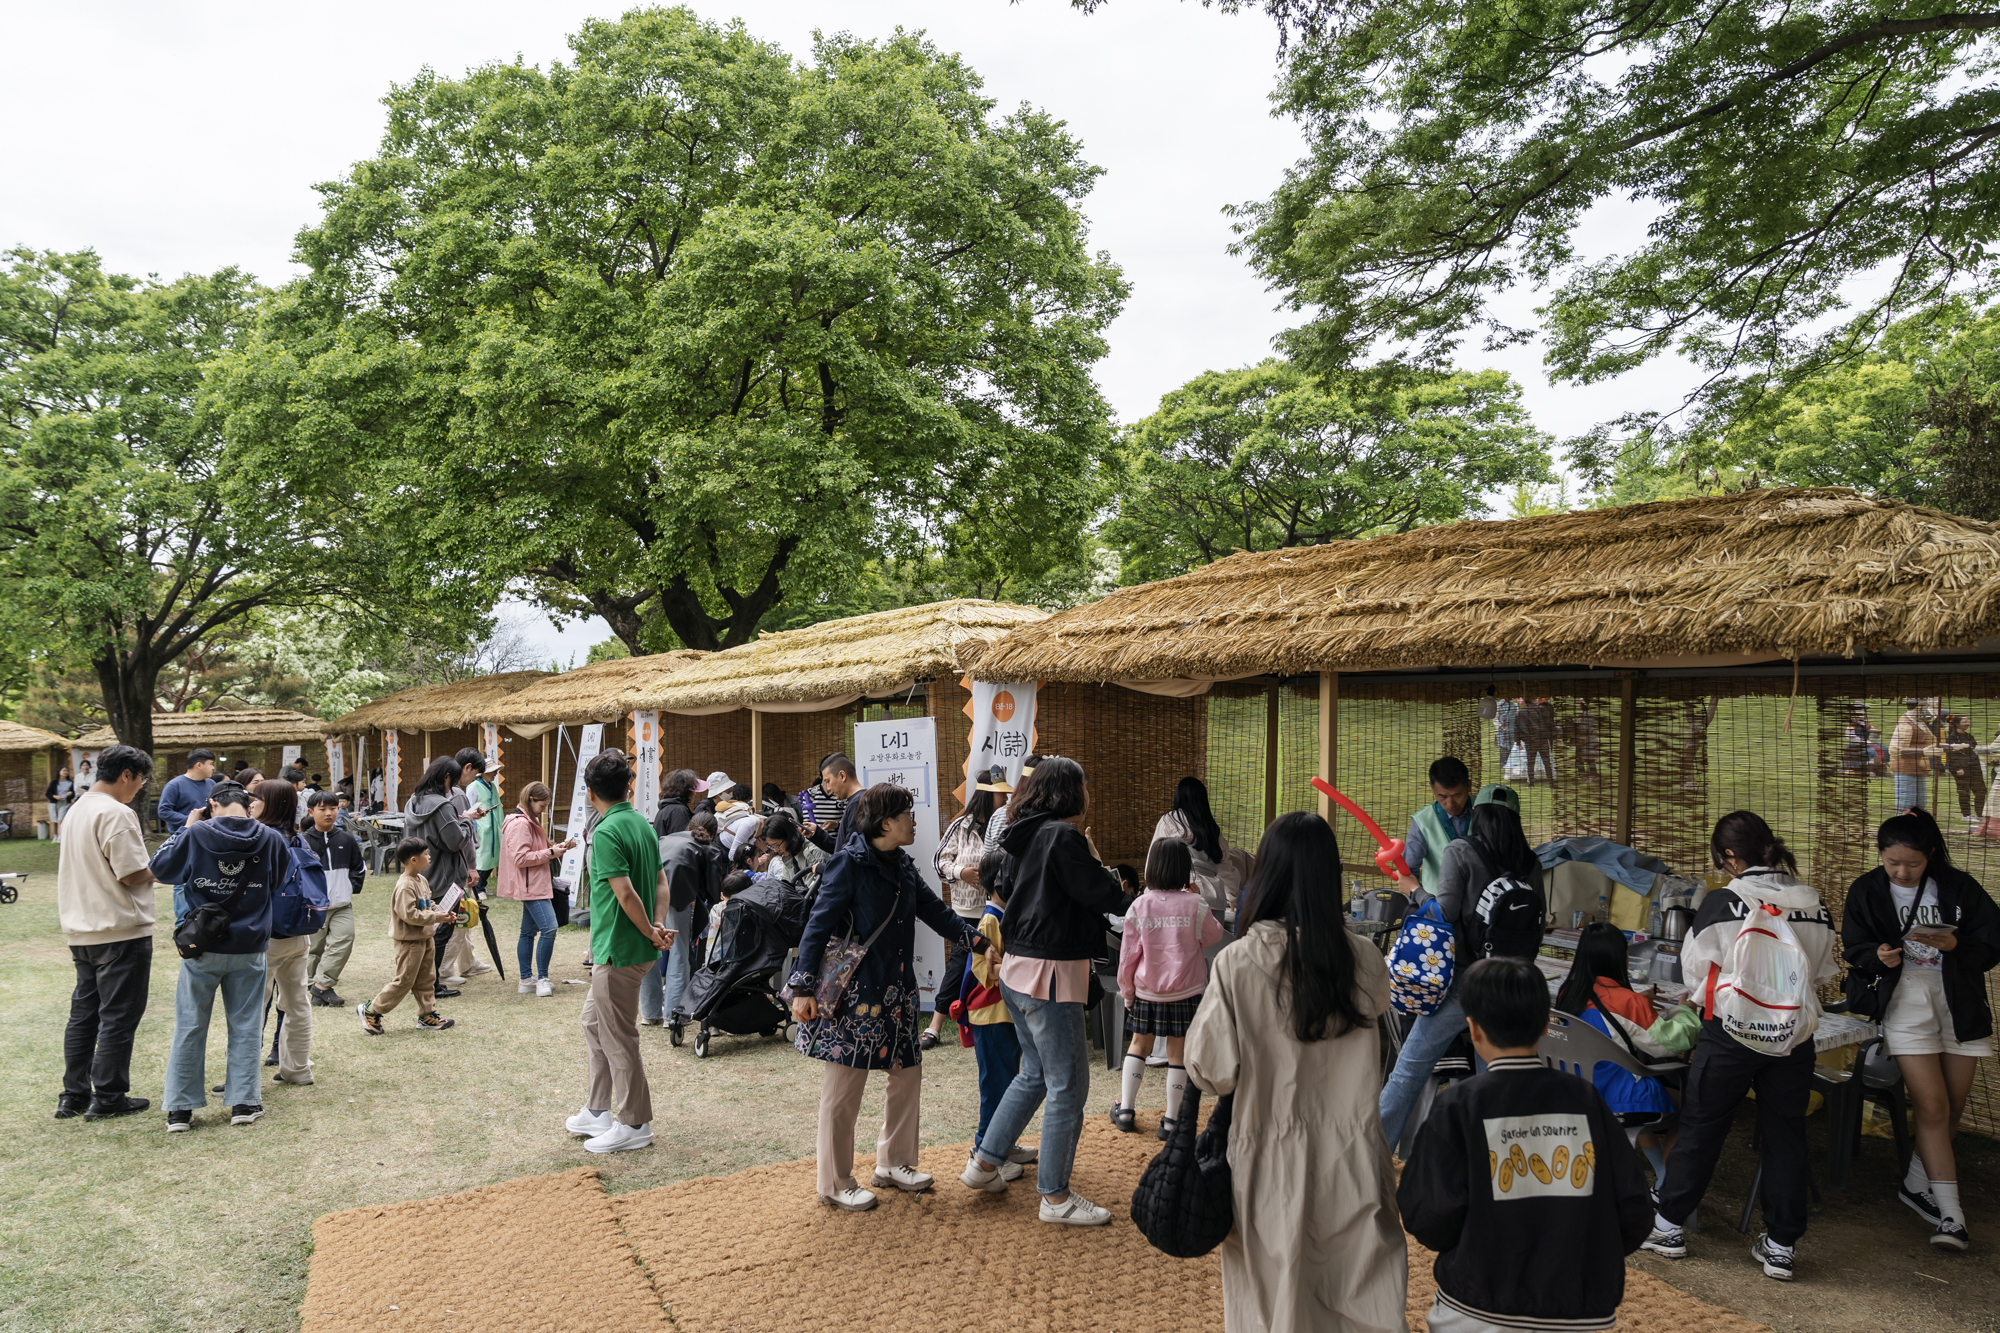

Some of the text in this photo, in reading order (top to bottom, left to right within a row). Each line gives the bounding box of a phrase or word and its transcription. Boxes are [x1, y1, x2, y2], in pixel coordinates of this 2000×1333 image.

[995, 703, 1013, 711] B존-18
[981, 730, 1028, 757] 시(詩)
[888, 772, 905, 785] 내가
[194, 877, 218, 888] Blue
[1138, 916, 1191, 929] YANKEES
[1726, 1014, 1796, 1032] THE ANIMALS
[1501, 1127, 1529, 1144] garder
[1530, 1126, 1541, 1137] un
